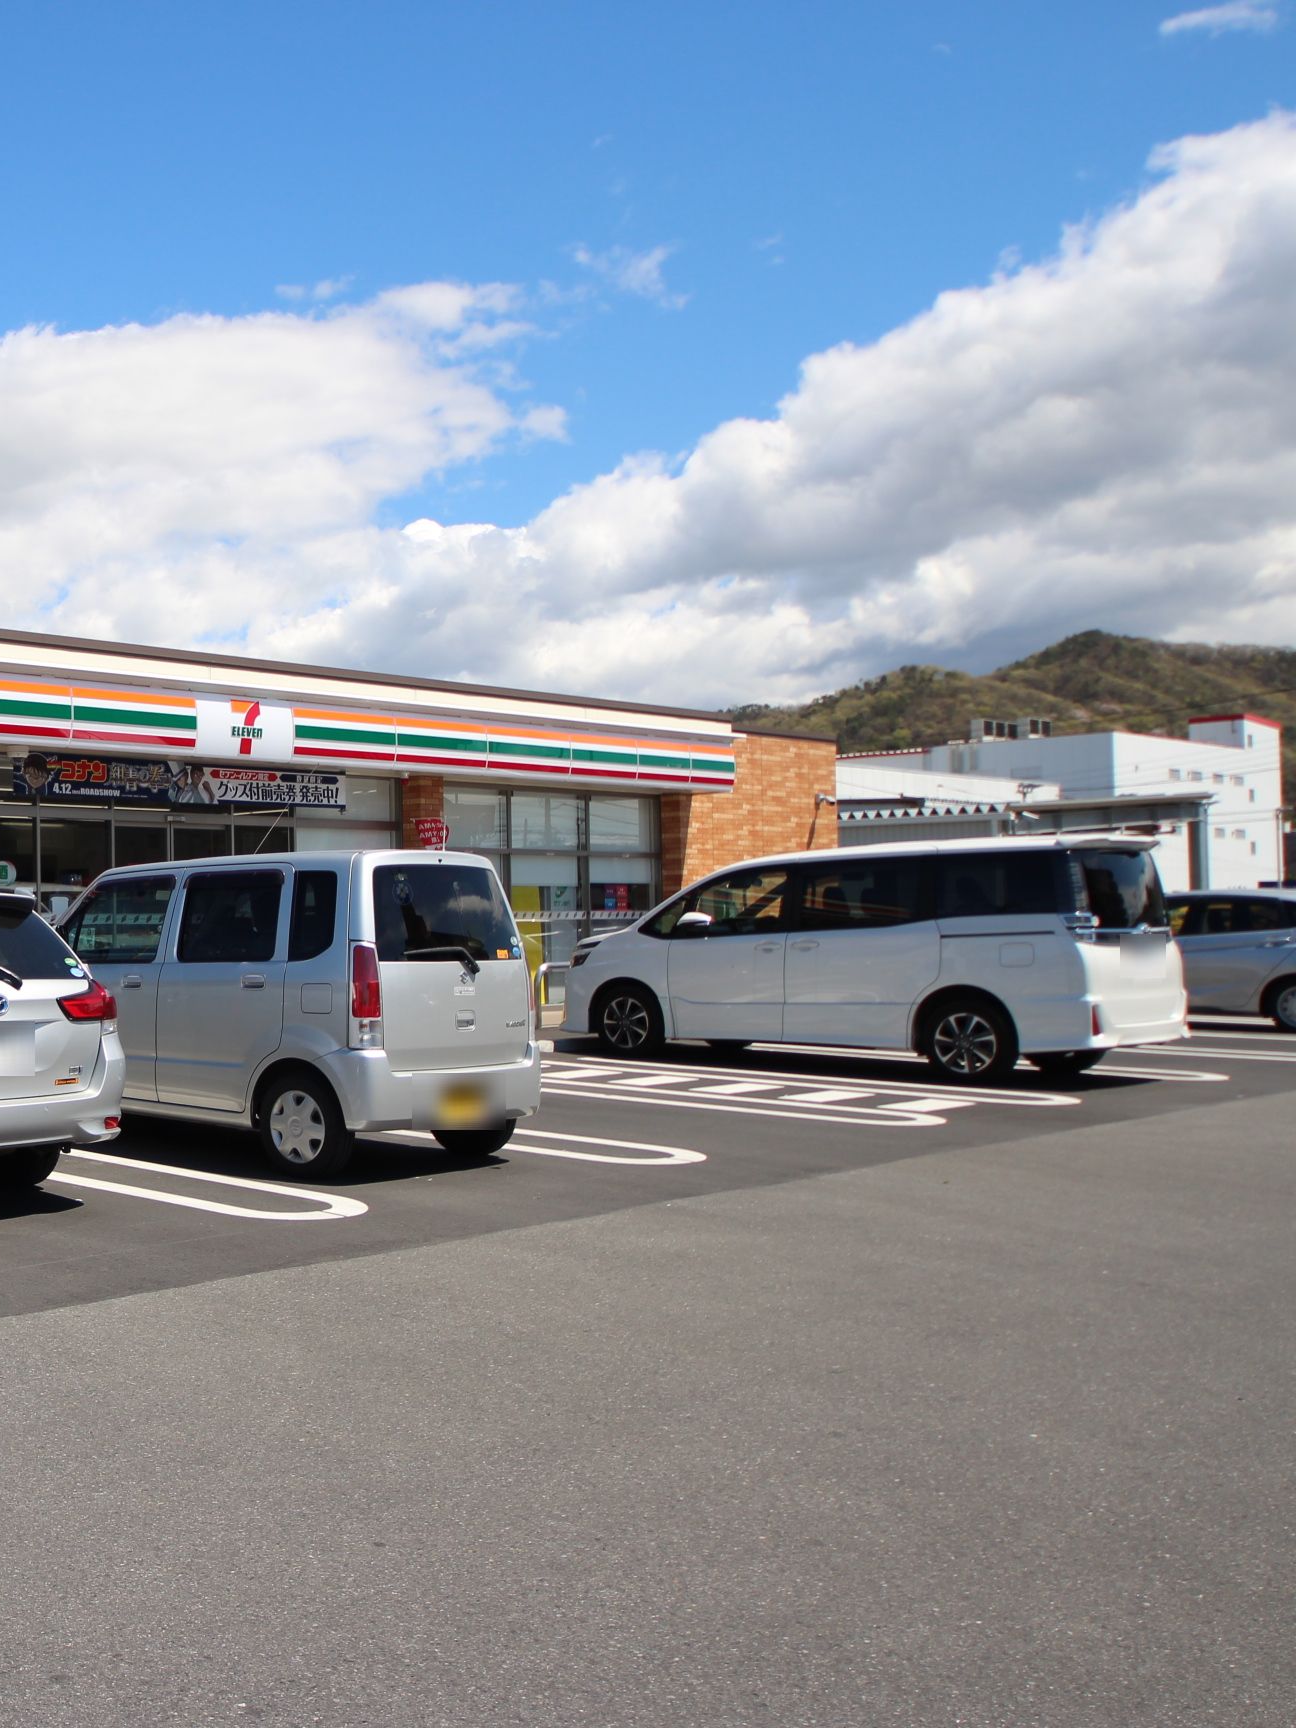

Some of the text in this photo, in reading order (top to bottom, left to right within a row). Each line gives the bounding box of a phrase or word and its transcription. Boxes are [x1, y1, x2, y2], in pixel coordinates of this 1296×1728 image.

[60, 760, 107, 783] コナン
[53, 784, 71, 794] 4.12
[80, 788, 120, 797] ROADSHOW
[218, 781, 339, 804] グッズ付前売券 発売中!
